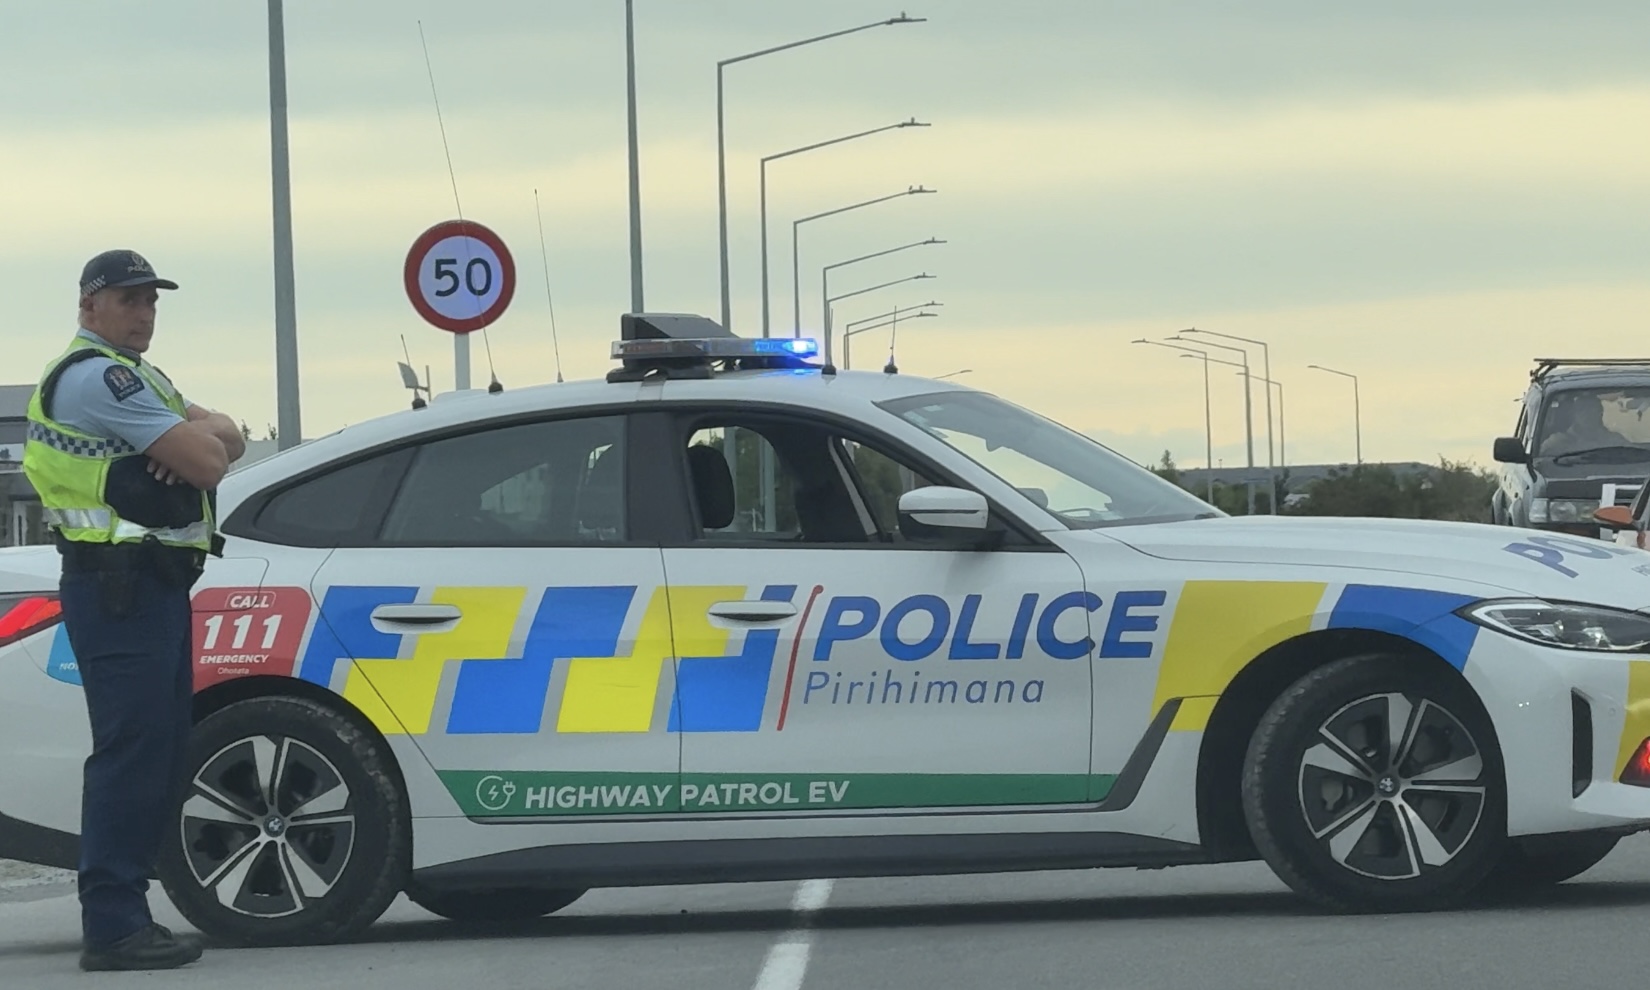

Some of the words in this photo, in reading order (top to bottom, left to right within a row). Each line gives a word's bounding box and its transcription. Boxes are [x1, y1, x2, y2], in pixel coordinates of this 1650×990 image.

[434, 257, 492, 297] 50
[229, 594, 270, 608] CALL
[202, 614, 283, 650] 111
[813, 590, 1167, 661] POLICE
[199, 654, 270, 664] EMERGENCY
[803, 669, 1045, 705] Pirihimana
[525, 784, 673, 809] HIGHWAY
[681, 782, 800, 806] PATROL
[808, 780, 850, 804] EV
